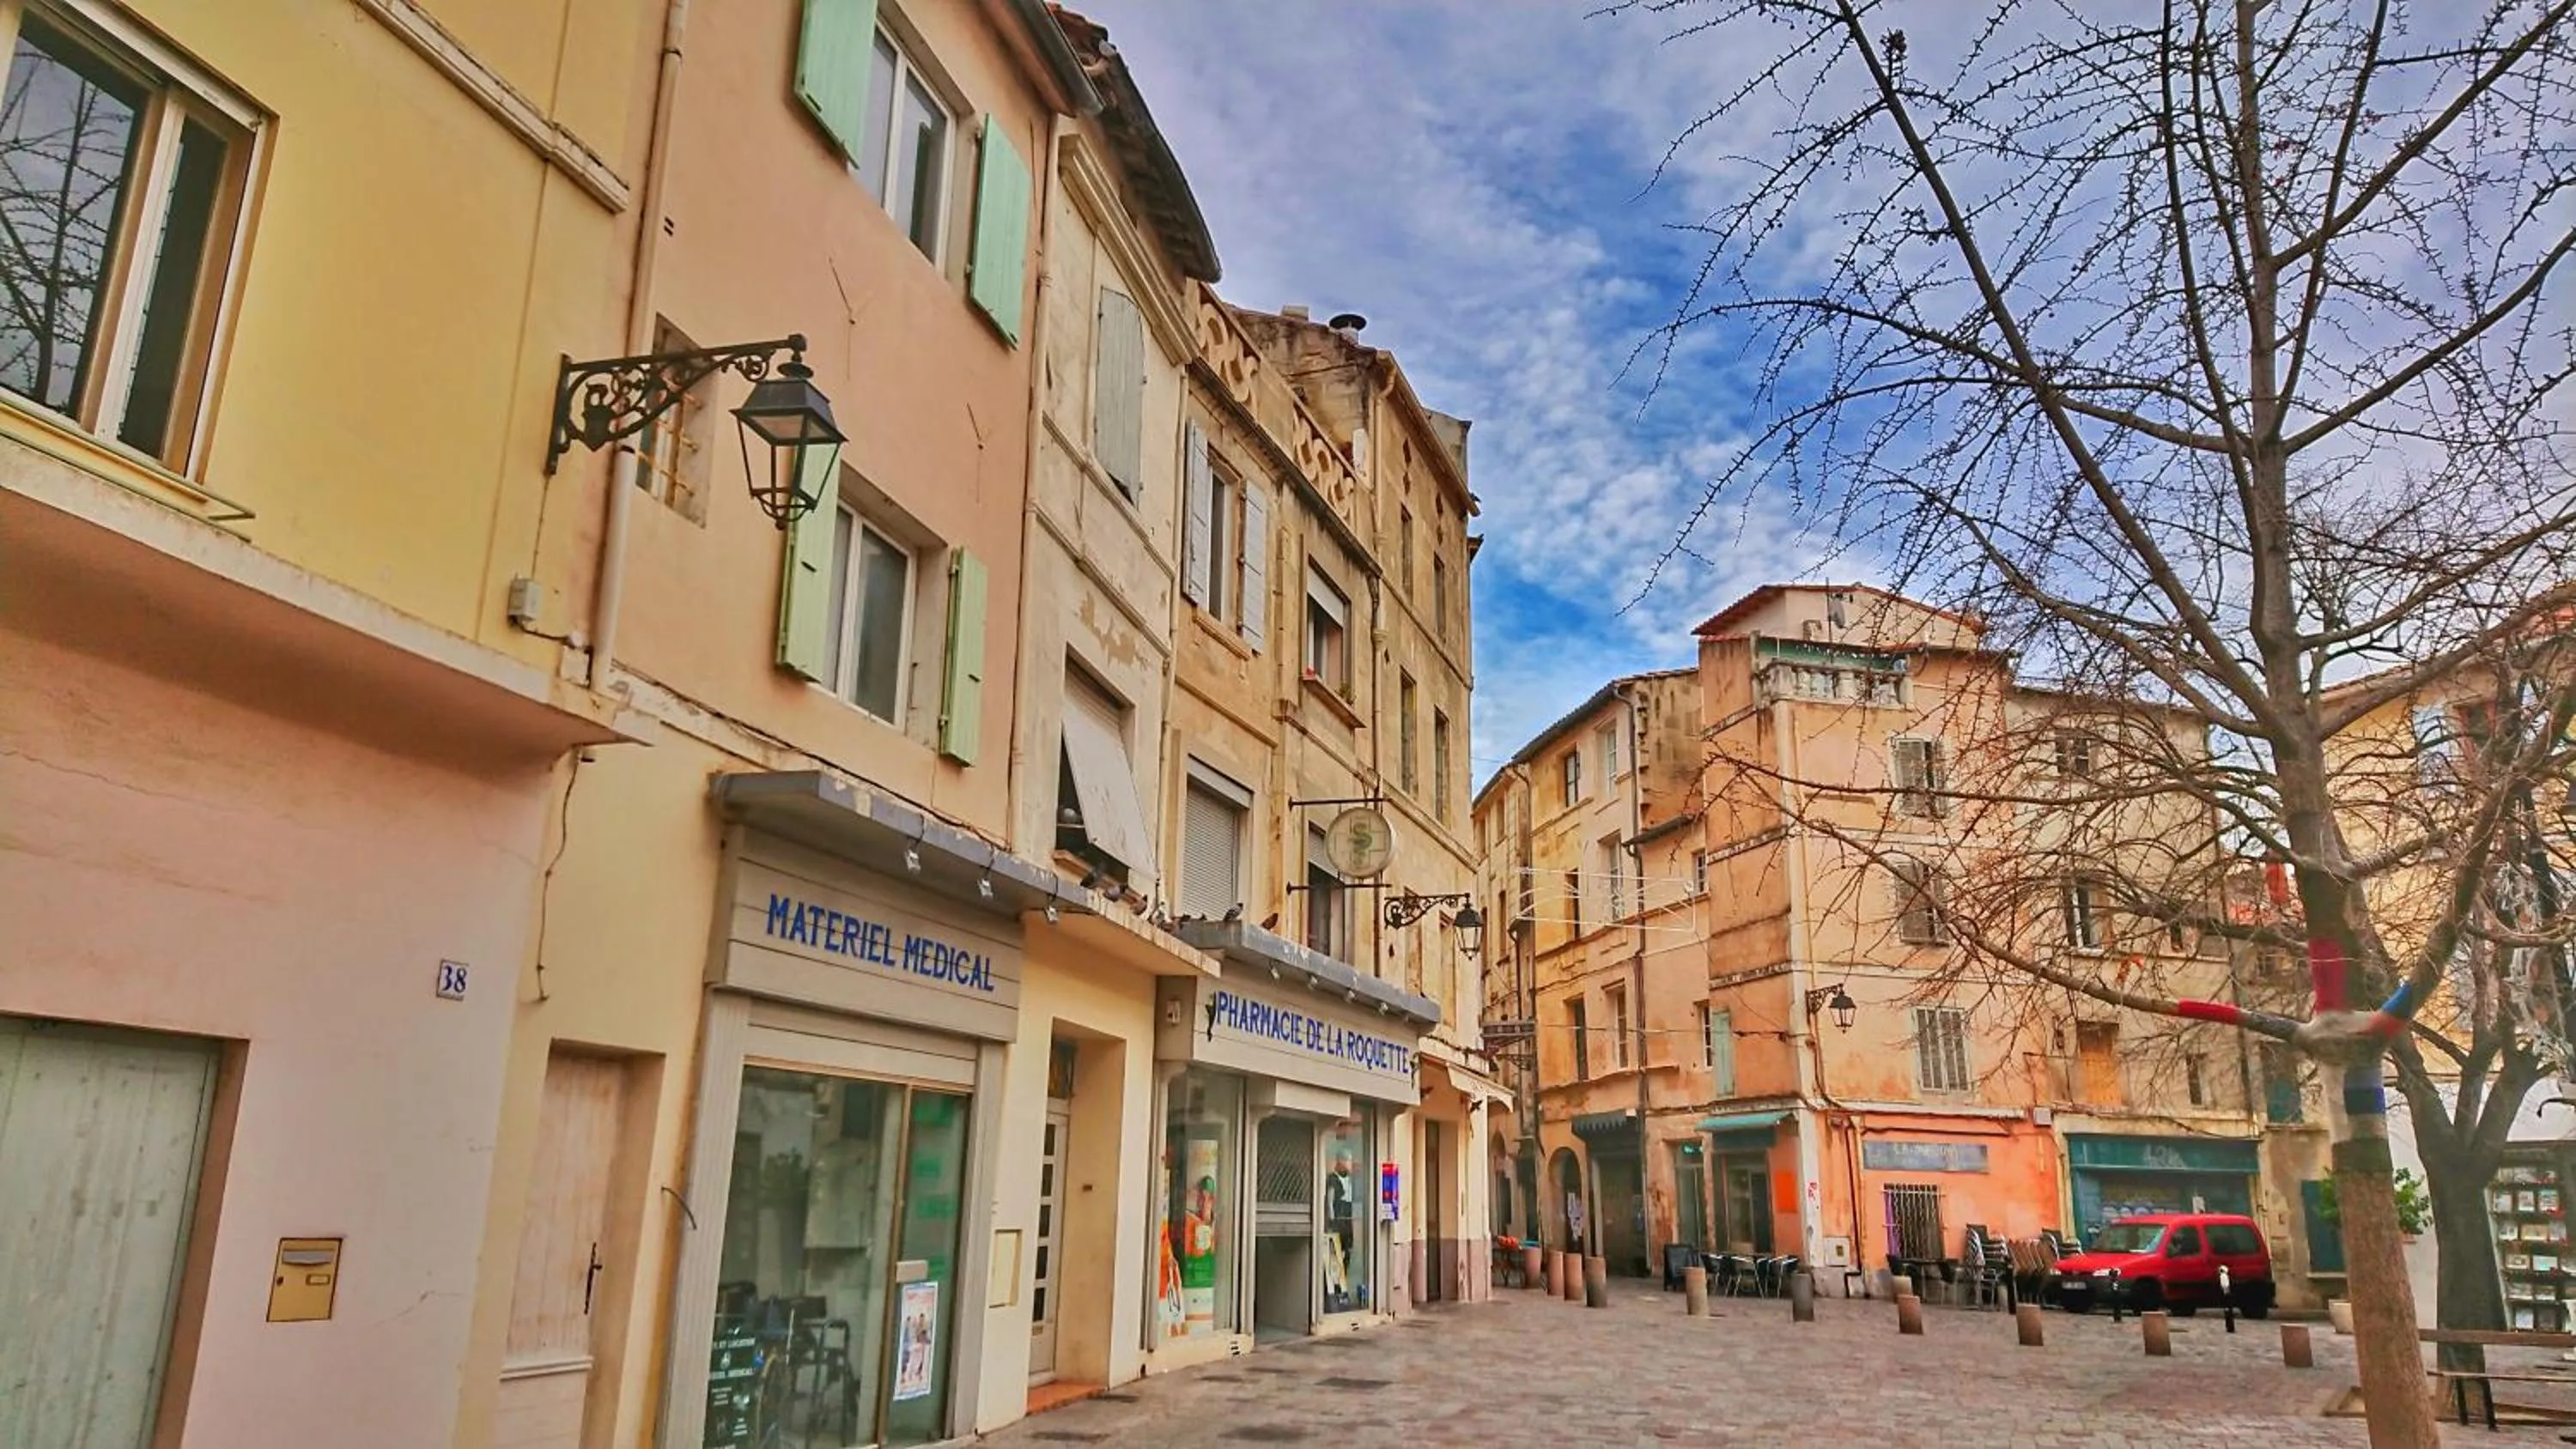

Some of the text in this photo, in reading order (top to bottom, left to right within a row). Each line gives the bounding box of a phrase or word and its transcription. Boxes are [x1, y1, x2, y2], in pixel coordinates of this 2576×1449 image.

[441, 965, 467, 993] 38
[766, 893, 995, 991] MATERIEL MEDICAL
[1217, 991, 1409, 1074] PHARMACIE DE LA ROQUETTE
